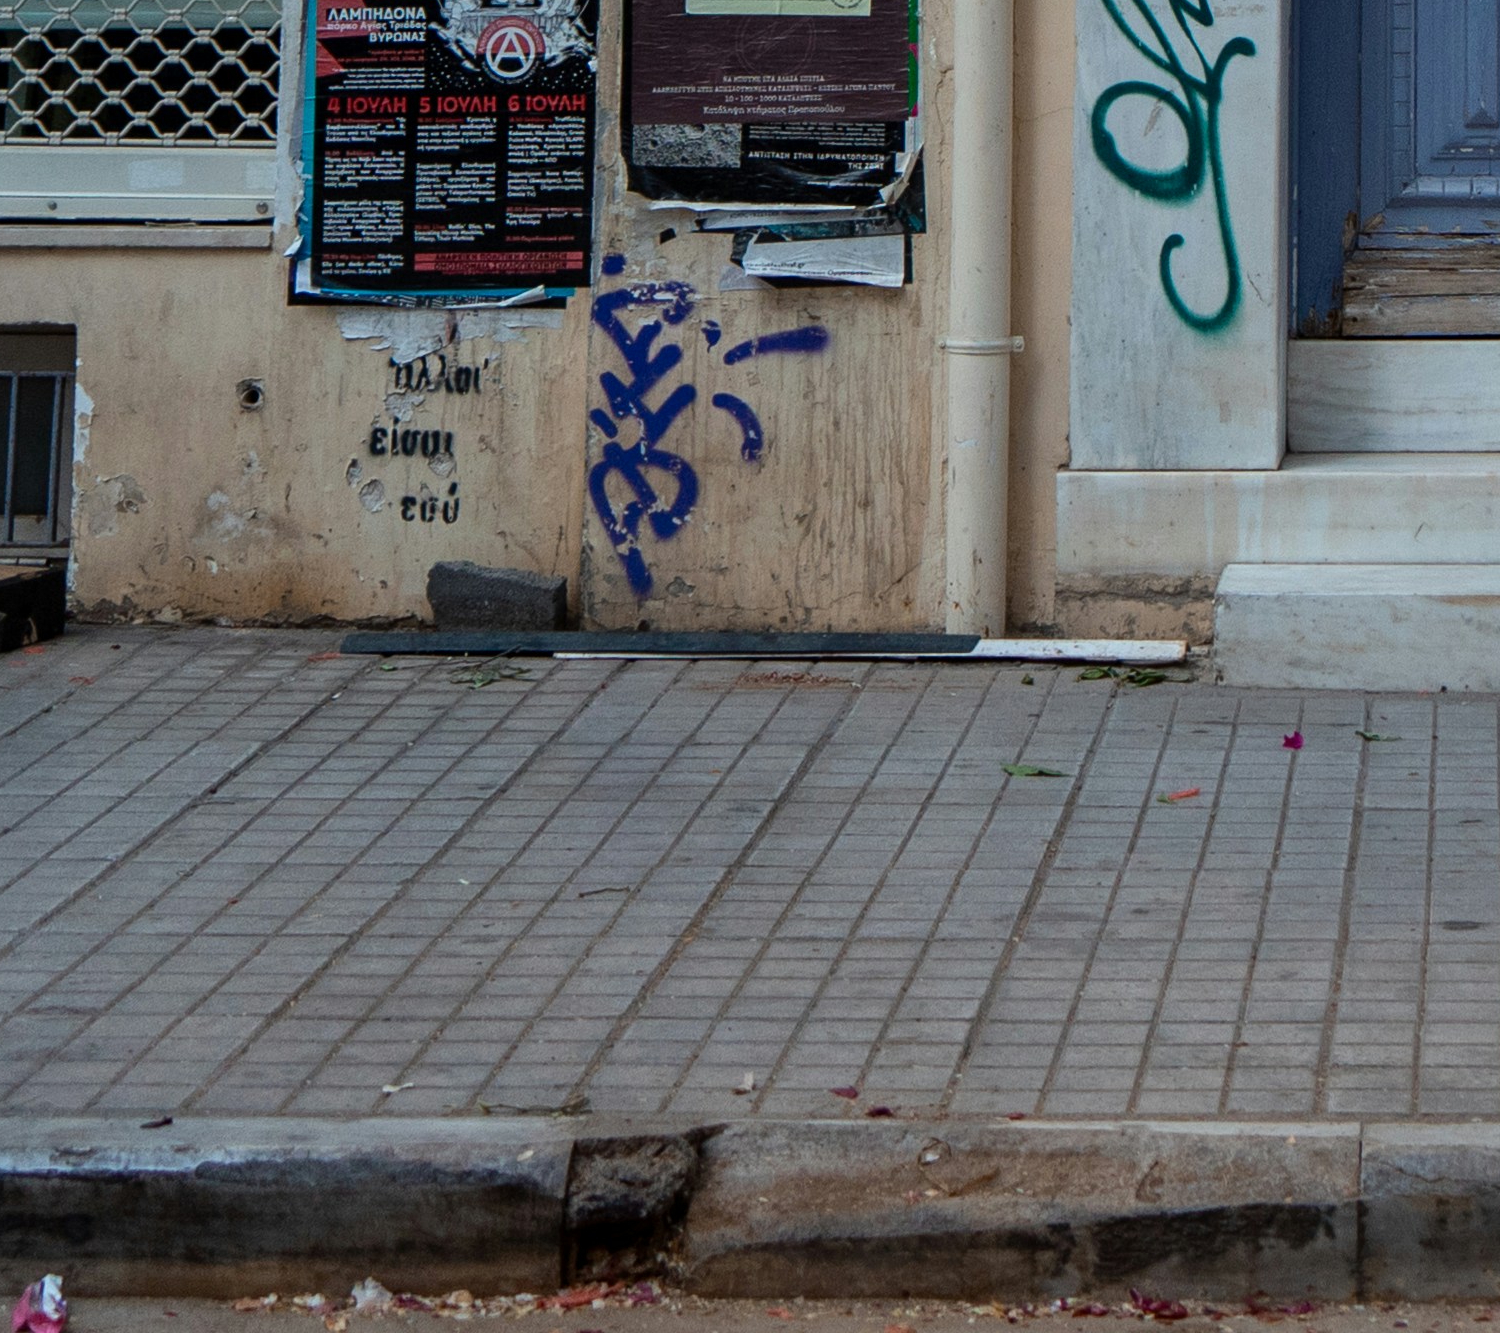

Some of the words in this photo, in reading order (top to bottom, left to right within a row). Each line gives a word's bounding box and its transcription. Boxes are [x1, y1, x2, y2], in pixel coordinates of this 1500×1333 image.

[328, 7, 426, 20] ΛΑΜΠΗΔΟΝΑ
[369, 31, 426, 42] ΒΥΡΩΝΑΣ
[327, 98, 340, 114] 4
[346, 96, 407, 113] ΙΟΥΛΗ
[419, 96, 431, 112] 5
[437, 95, 497, 112] ΙΟΥΛΗ
[507, 95, 519, 111] 6
[526, 94, 586, 111] ΙΟΥΛΗ
